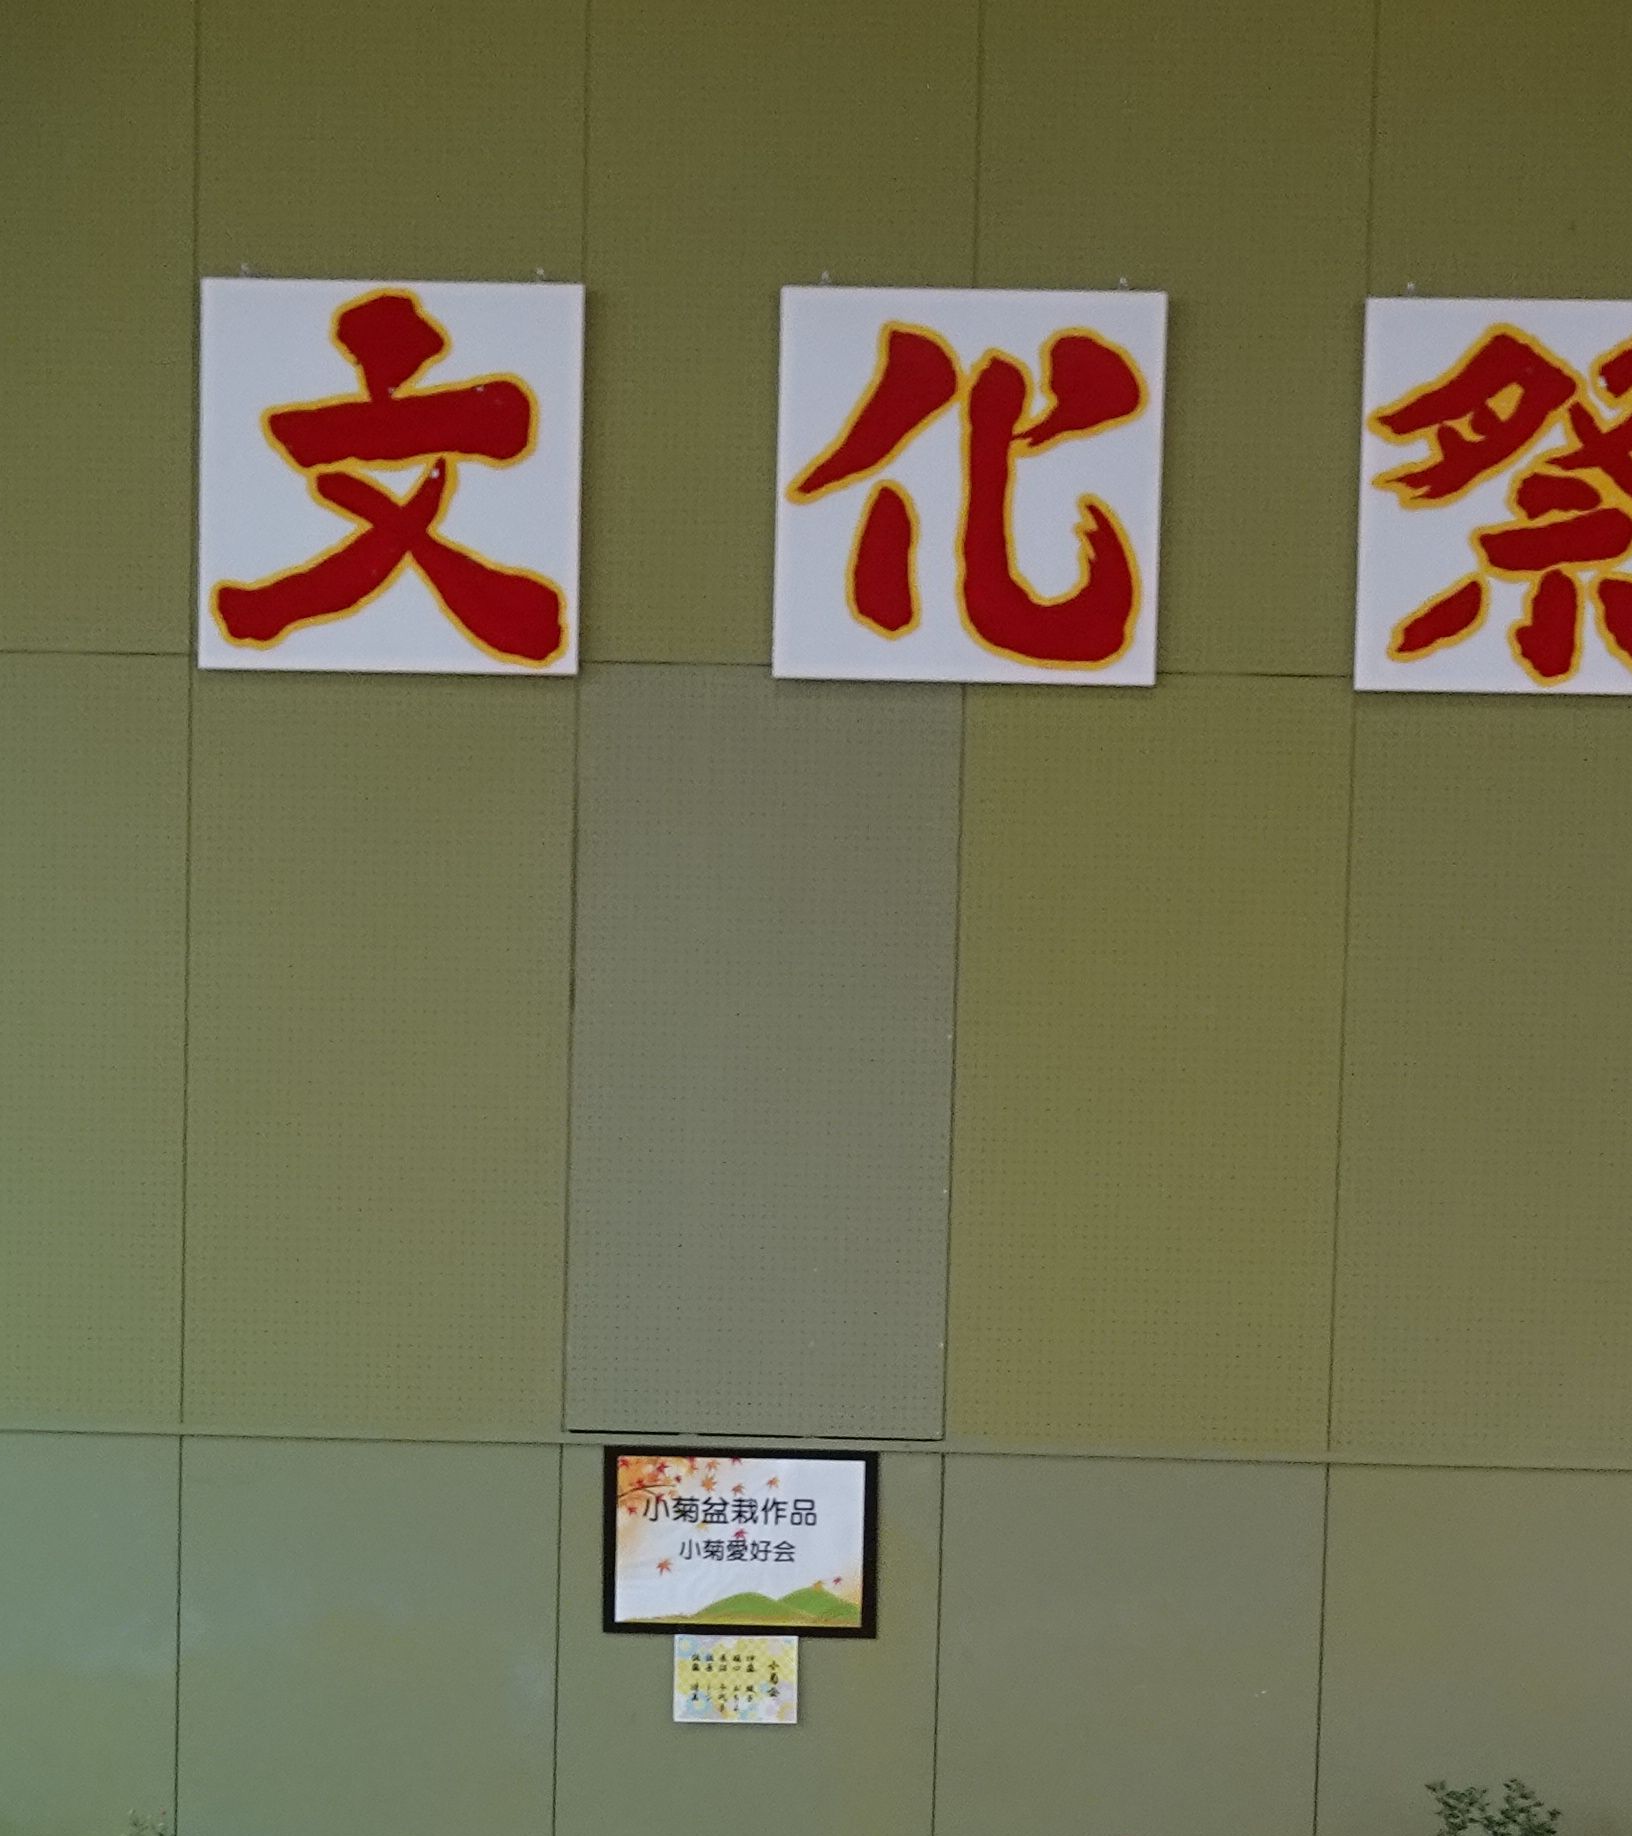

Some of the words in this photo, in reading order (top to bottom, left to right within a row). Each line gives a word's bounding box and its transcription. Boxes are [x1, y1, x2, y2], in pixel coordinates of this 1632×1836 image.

[642, 1496, 818, 1527] 小菊盆栽作品
[678, 1538, 797, 1563] 小菊愛好会
